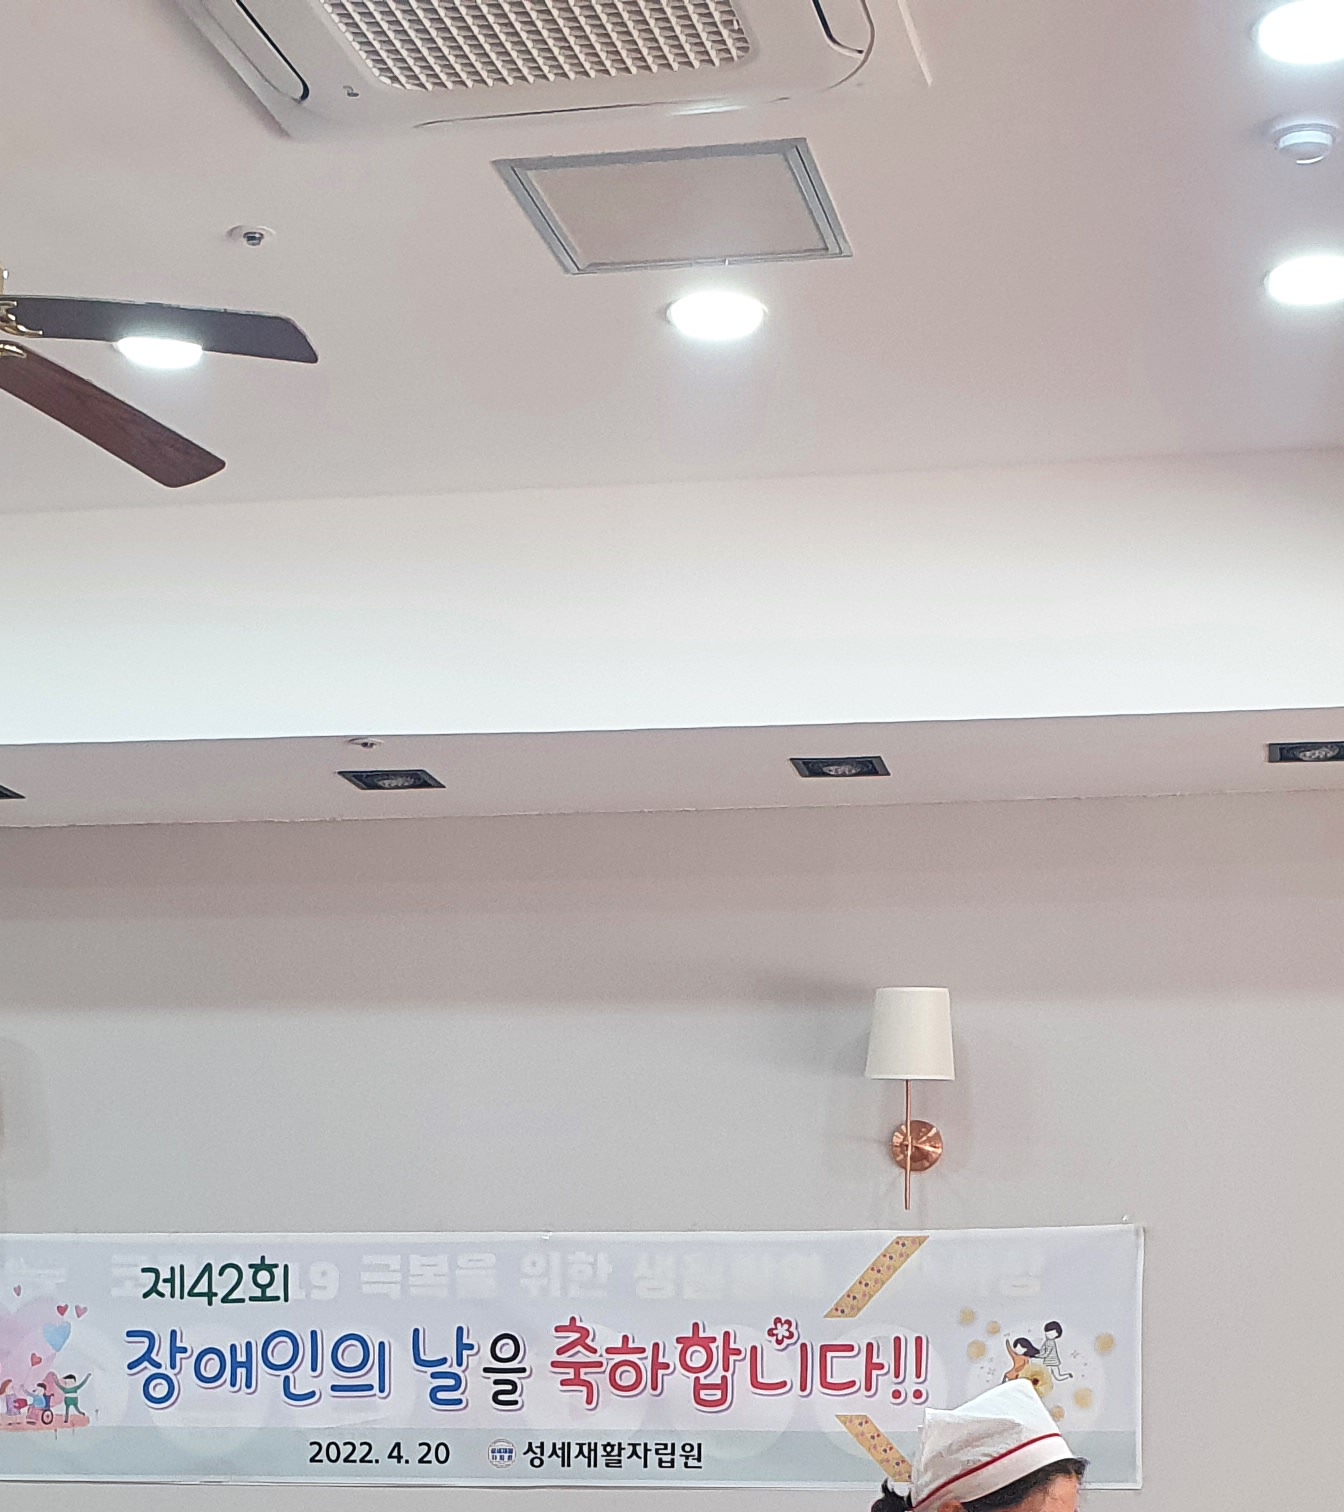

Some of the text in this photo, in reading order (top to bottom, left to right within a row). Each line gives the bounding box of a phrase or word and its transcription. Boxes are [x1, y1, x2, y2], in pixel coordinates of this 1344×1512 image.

[140, 1255, 290, 1306] 제42회
[124, 1315, 931, 1412] 장애인의 날을 축하합니다!!
[308, 1441, 451, 1465] 2022. 4. 20
[522, 1440, 703, 1469] 성세재활자립원
